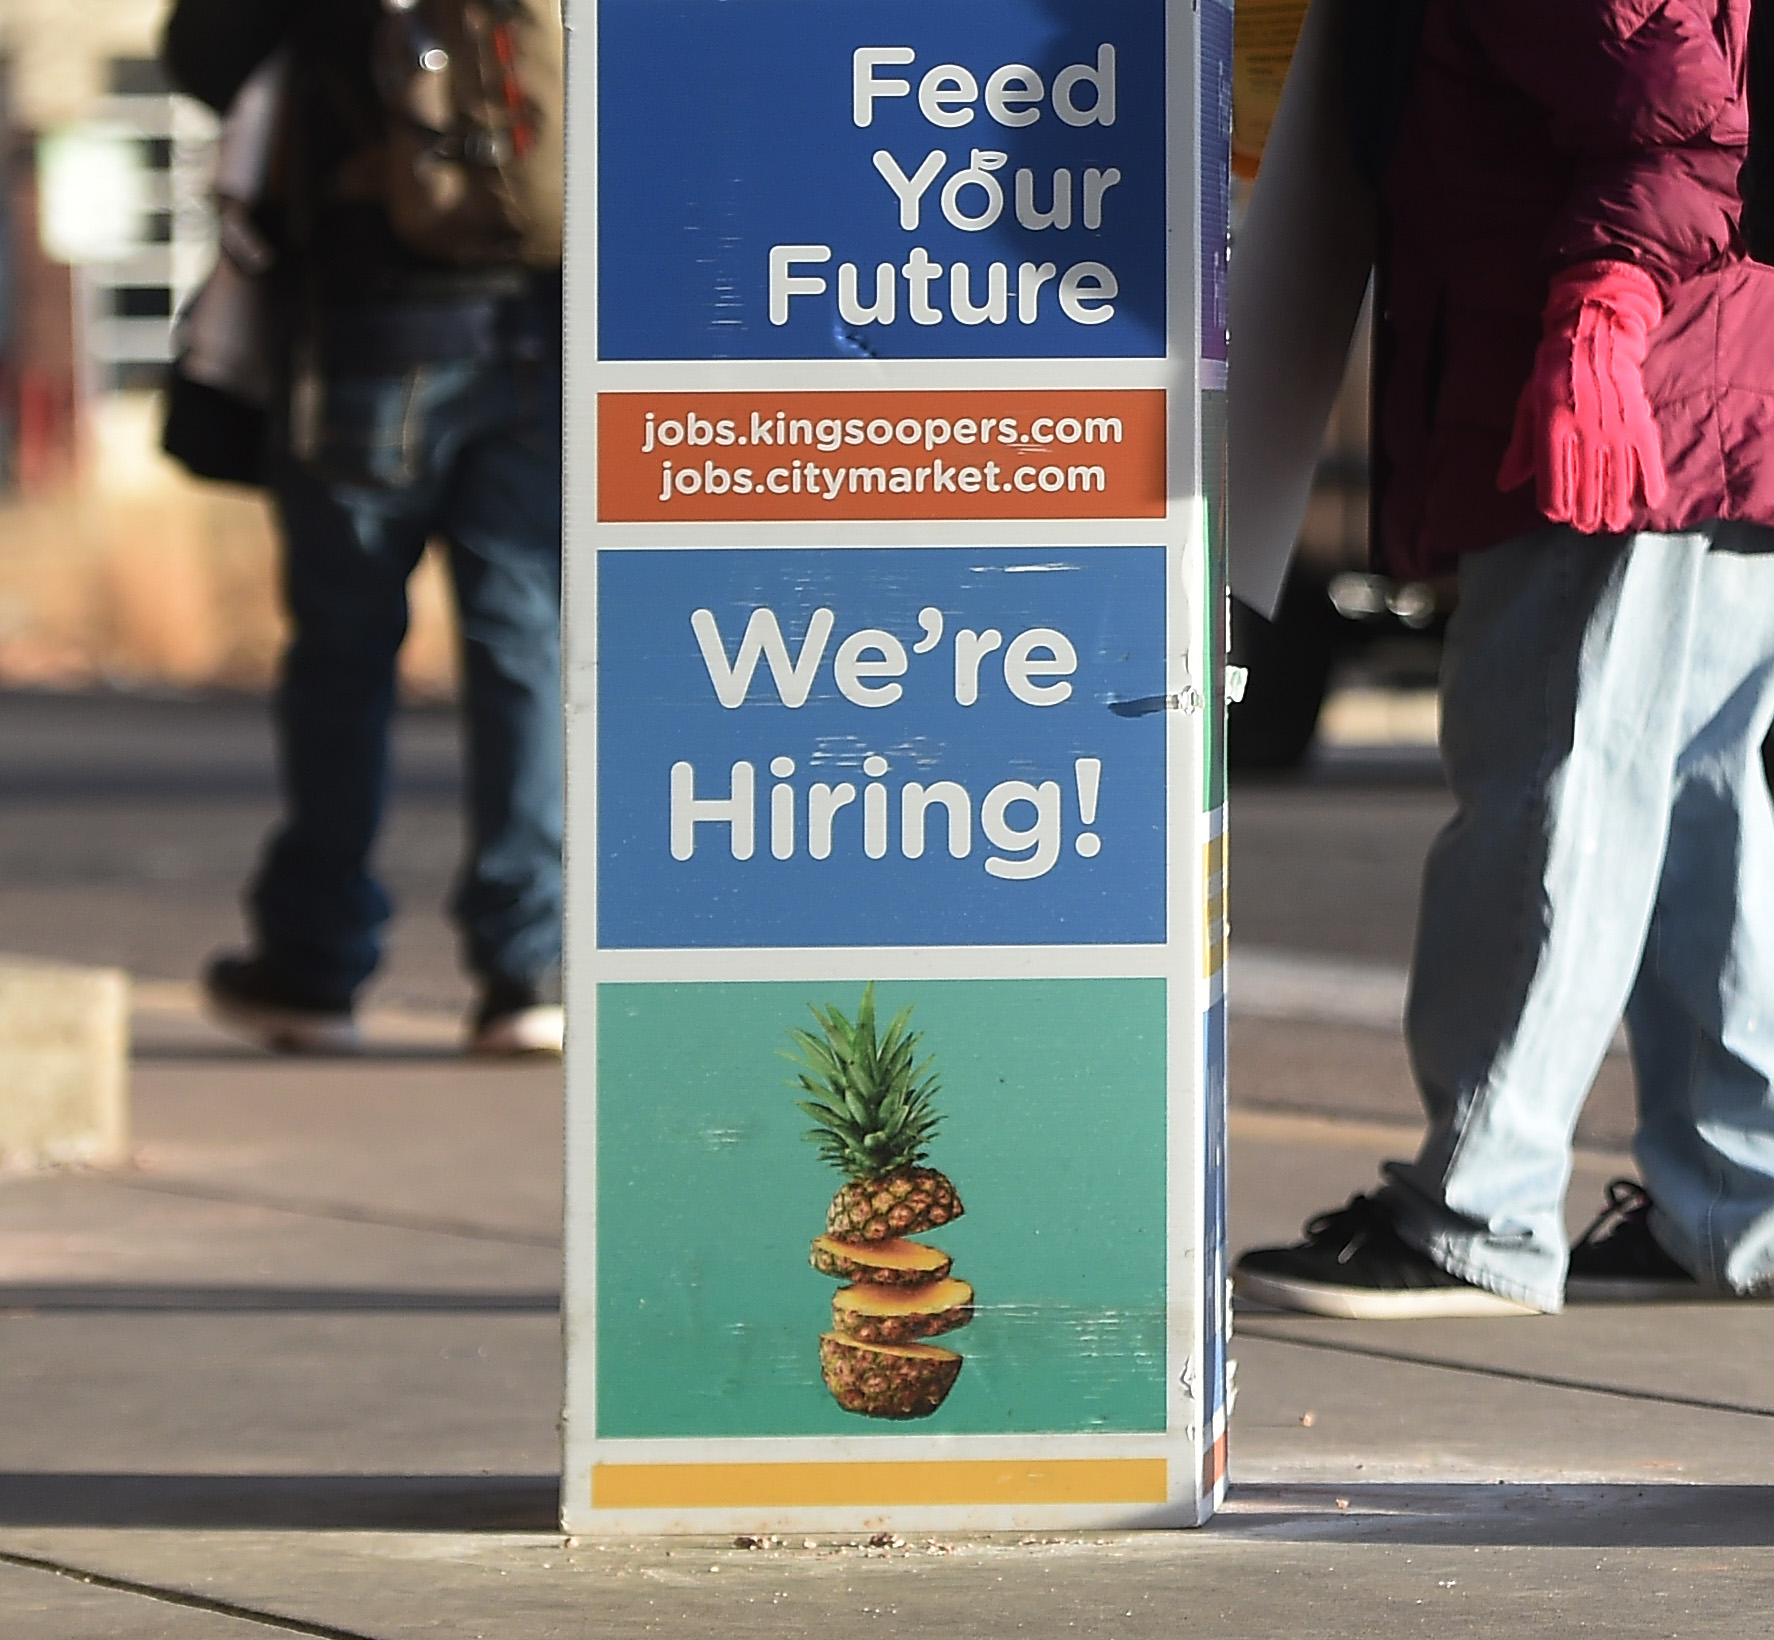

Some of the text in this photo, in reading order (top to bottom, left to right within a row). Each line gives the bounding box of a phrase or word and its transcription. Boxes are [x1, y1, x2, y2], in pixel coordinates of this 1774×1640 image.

[853, 43, 1116, 127] Feed
[873, 148, 1120, 231] Your
[768, 245, 1119, 325] Future
[642, 412, 1123, 452] jobs.kingsoopers.com
[659, 459, 1106, 501] jobs.citymarket.com
[690, 606, 1078, 709] We're
[670, 756, 1101, 880] Hiring!
